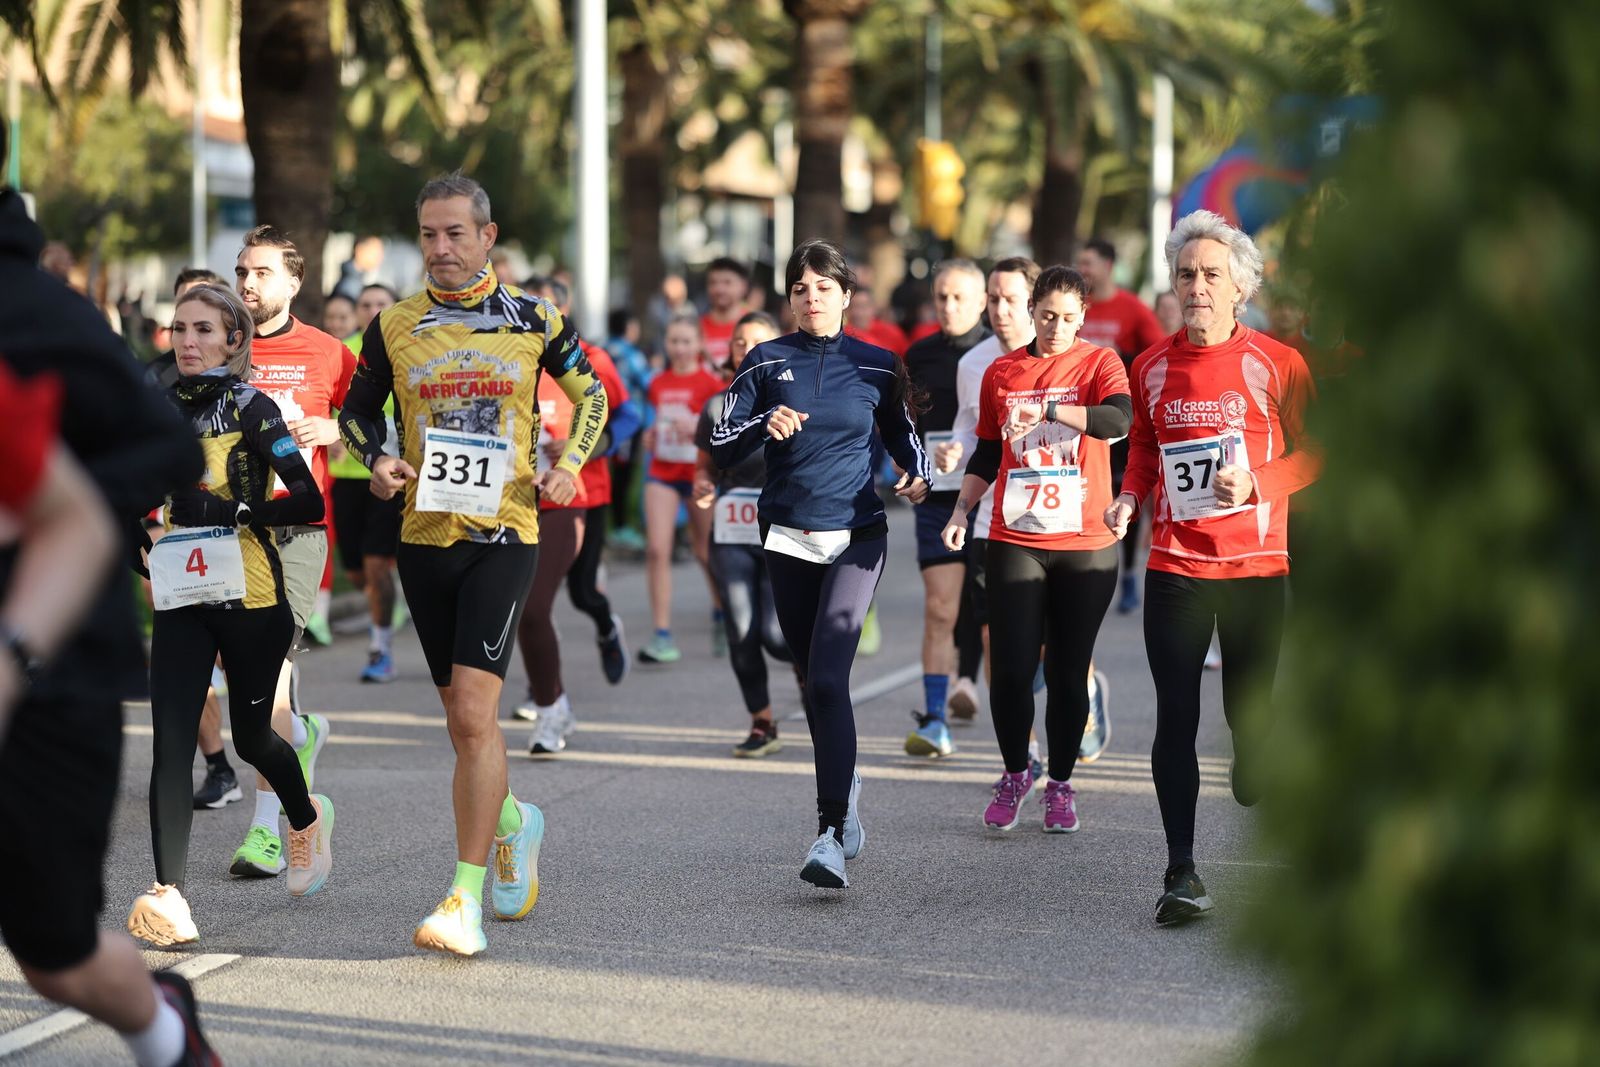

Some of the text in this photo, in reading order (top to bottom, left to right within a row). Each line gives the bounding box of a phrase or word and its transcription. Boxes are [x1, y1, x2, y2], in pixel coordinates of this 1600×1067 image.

[265, 370, 305, 380] JARDÍN
[419, 380, 514, 400] AFRICANUS
[1006, 392, 1079, 406] CIUDAD JARDÍN
[1044, 386, 1070, 394] URBANA
[1163, 398, 1219, 417] XII CROSS
[577, 394, 606, 455] AFRICANUS
[1164, 412, 1223, 424] DEL RECTOR
[427, 451, 491, 488] 331
[1024, 483, 1061, 510] 78
[185, 547, 208, 577] 4
